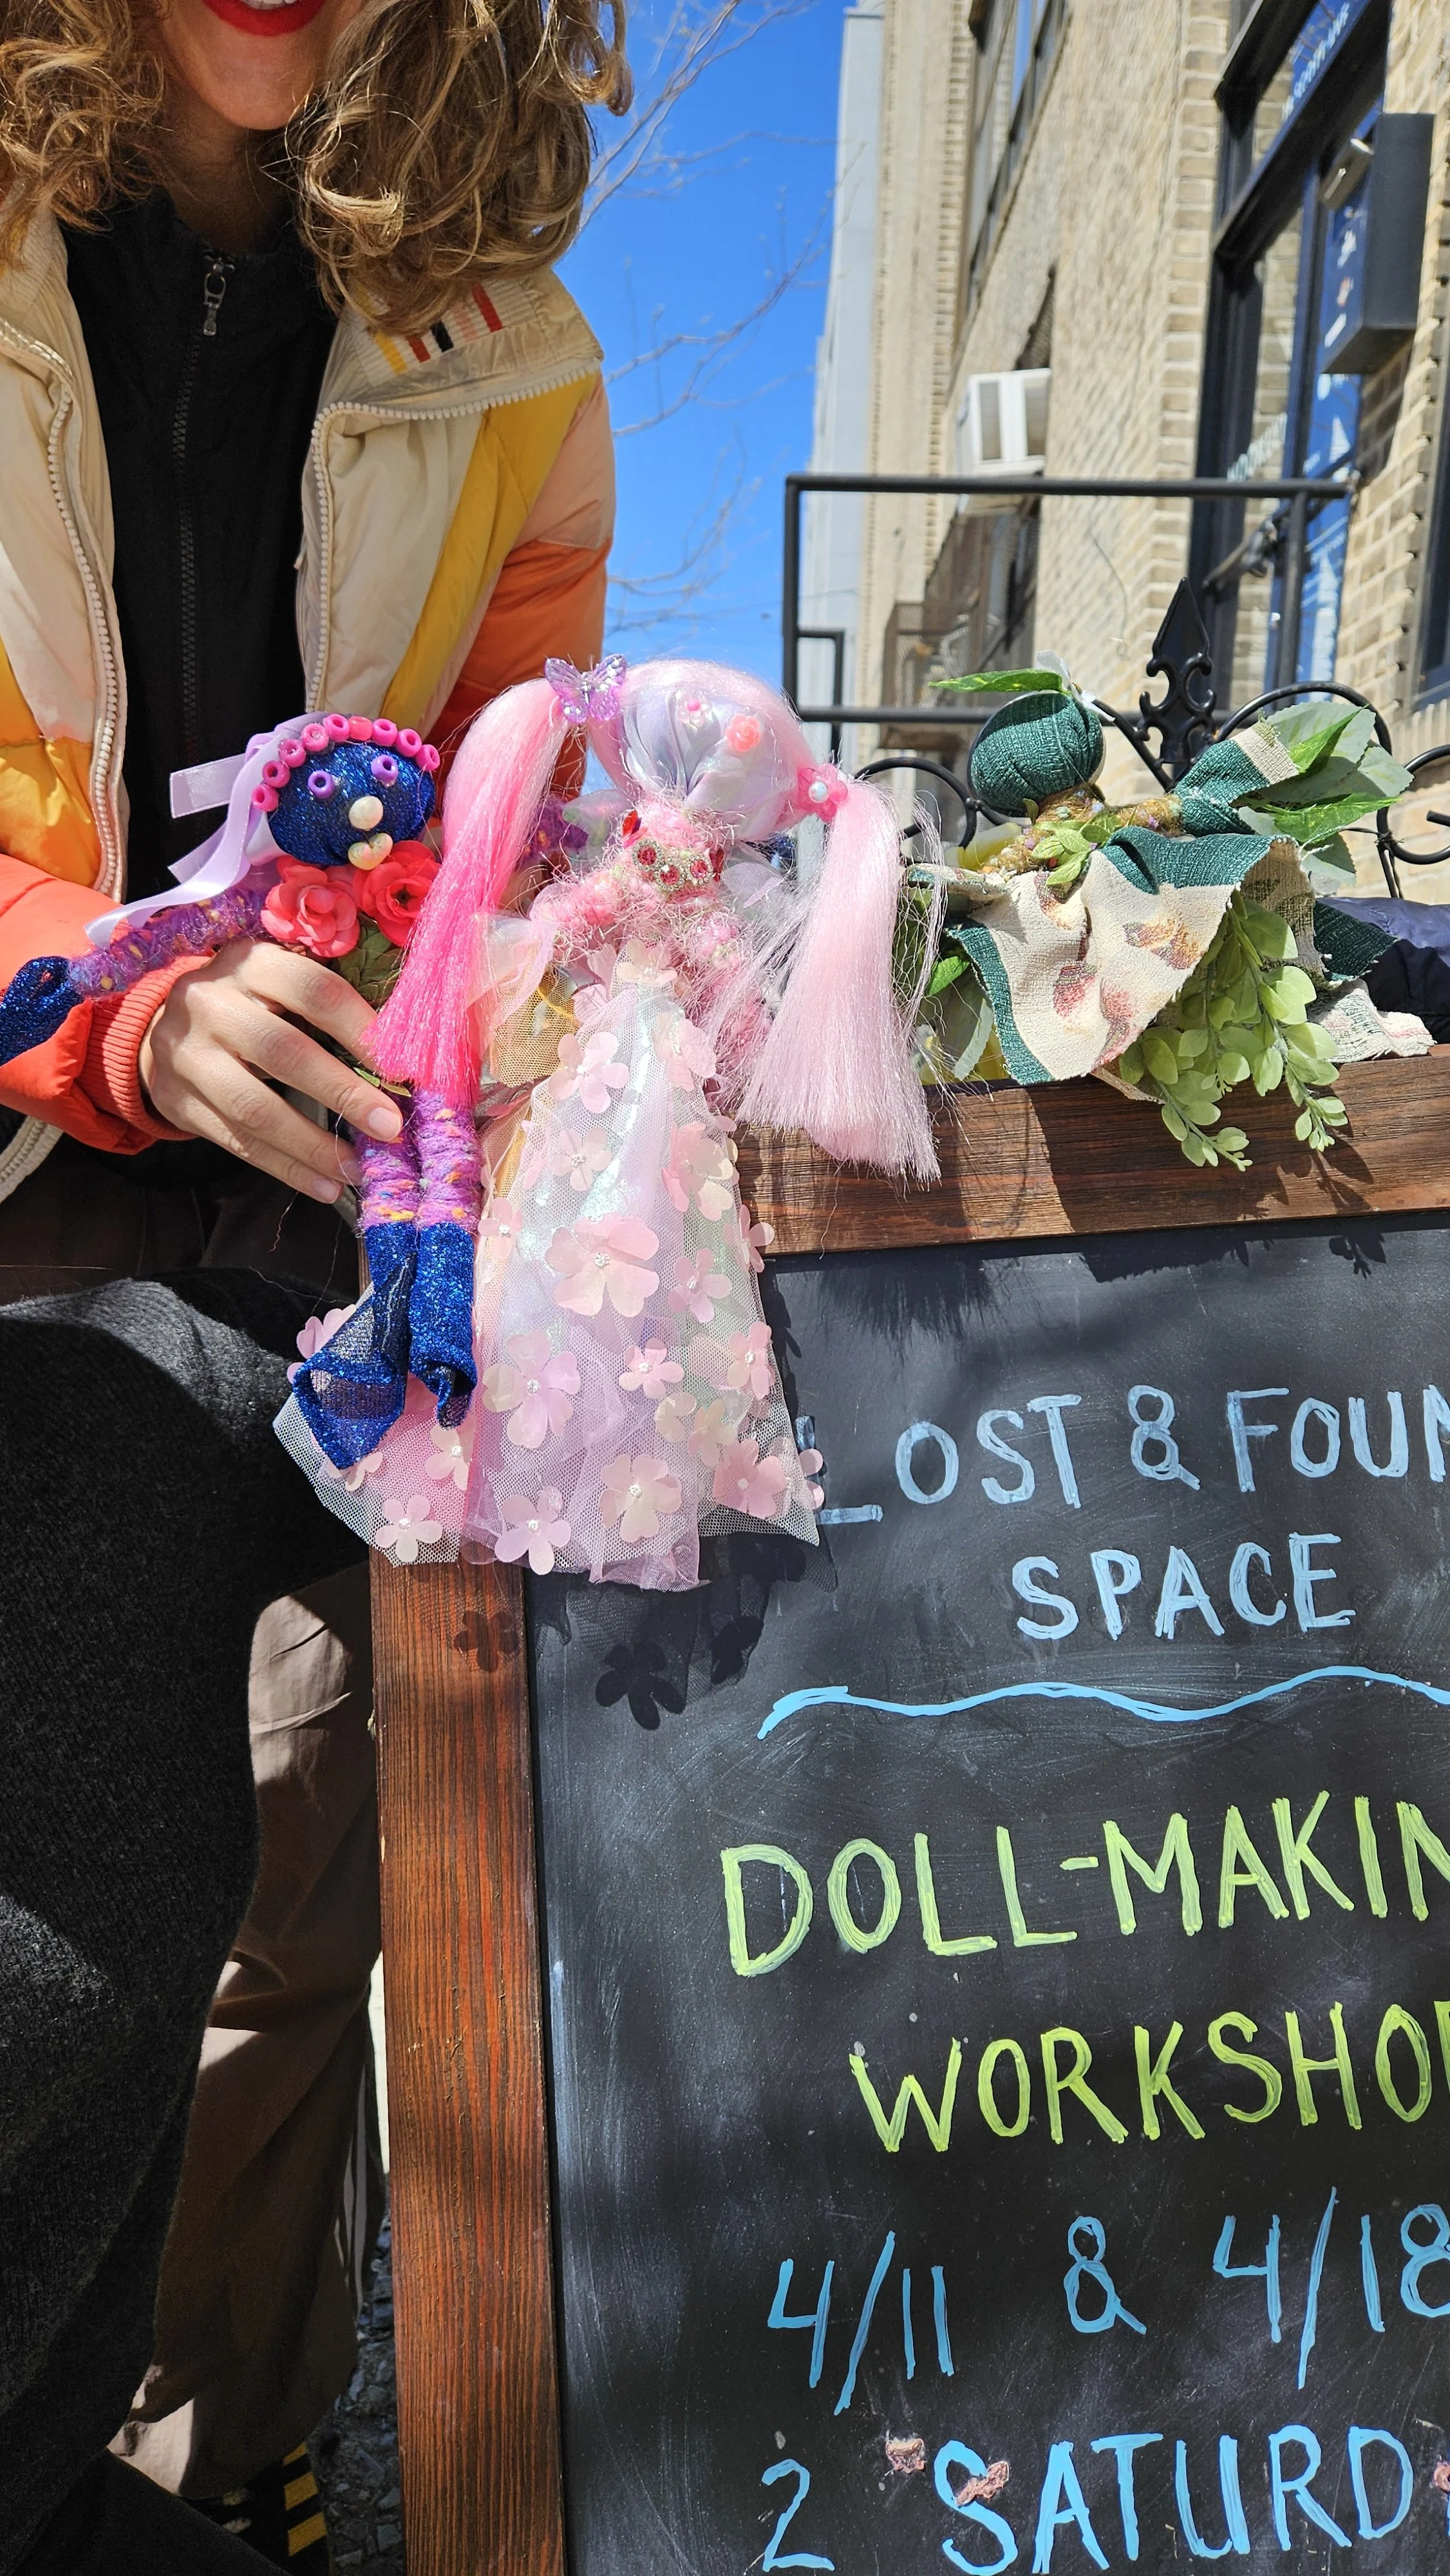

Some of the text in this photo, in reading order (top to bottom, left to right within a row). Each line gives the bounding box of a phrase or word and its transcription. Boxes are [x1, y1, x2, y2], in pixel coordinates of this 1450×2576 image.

[1127, 1385, 1200, 1490] &
[1012, 1531, 1356, 1641] SPACE
[849, 2000, 1450, 2152] WORKSHO
[767, 2186, 1450, 2416] 4/11 & 4/18
[761, 2424, 1450, 2576] 2 SATURD
